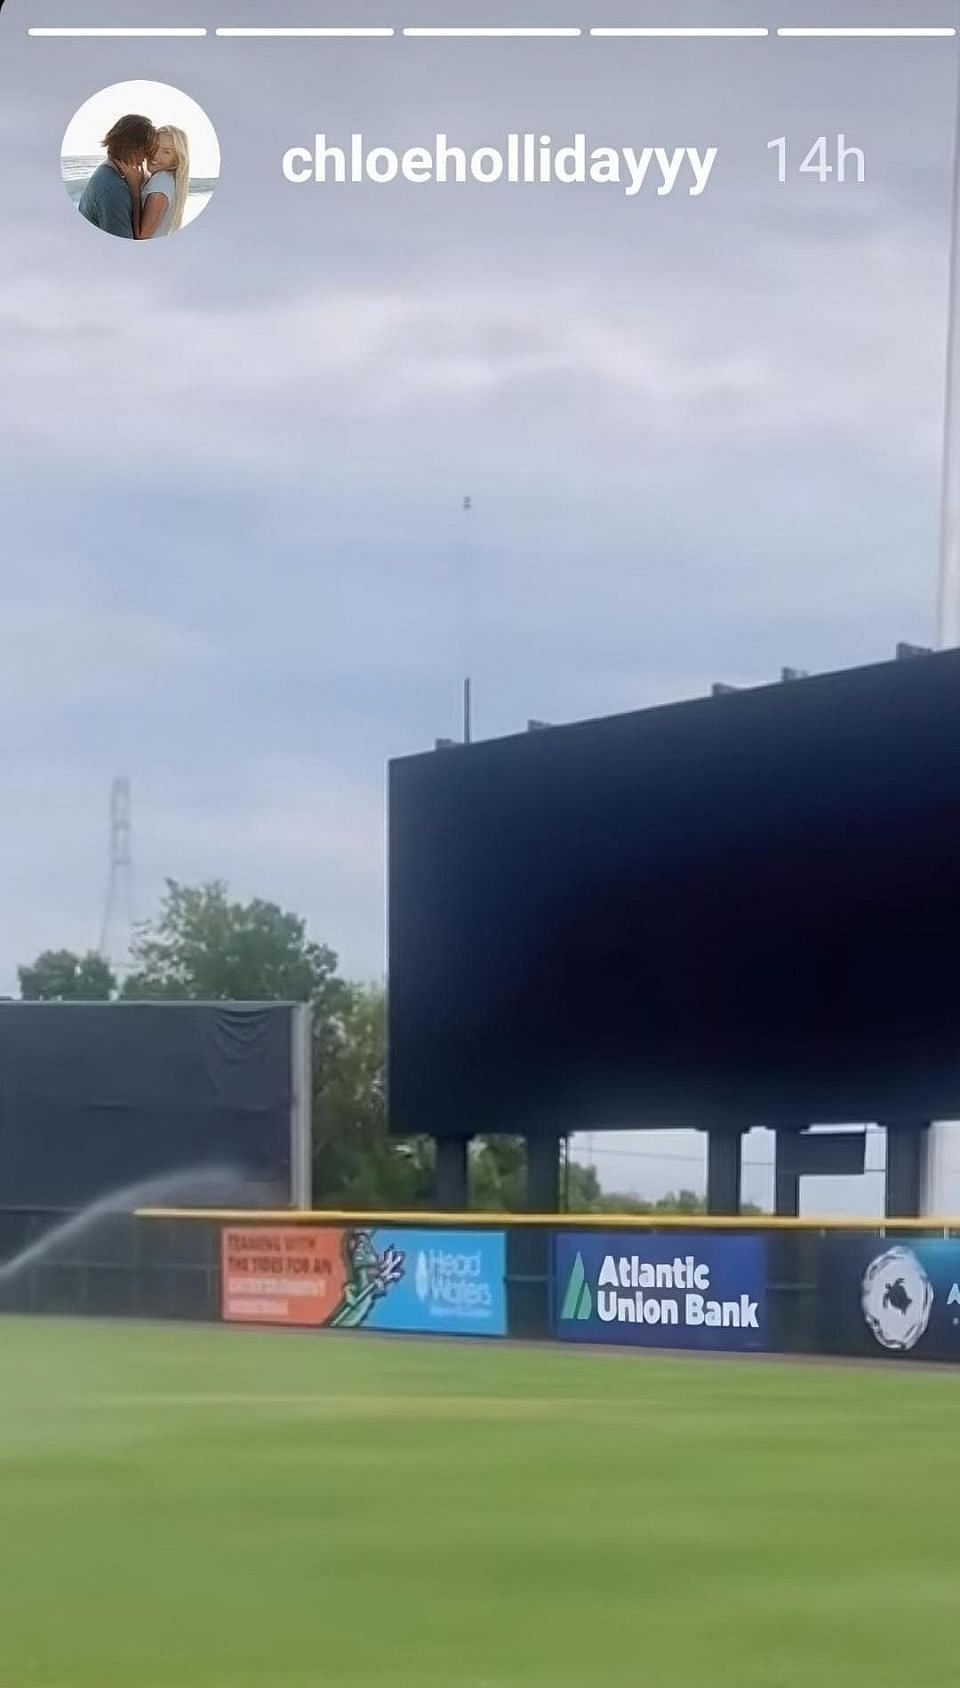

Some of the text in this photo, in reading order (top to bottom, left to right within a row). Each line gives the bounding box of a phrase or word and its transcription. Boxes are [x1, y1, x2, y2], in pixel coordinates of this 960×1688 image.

[597, 1255, 711, 1290] Atlantic
[597, 1290, 760, 1328] Union Bank
